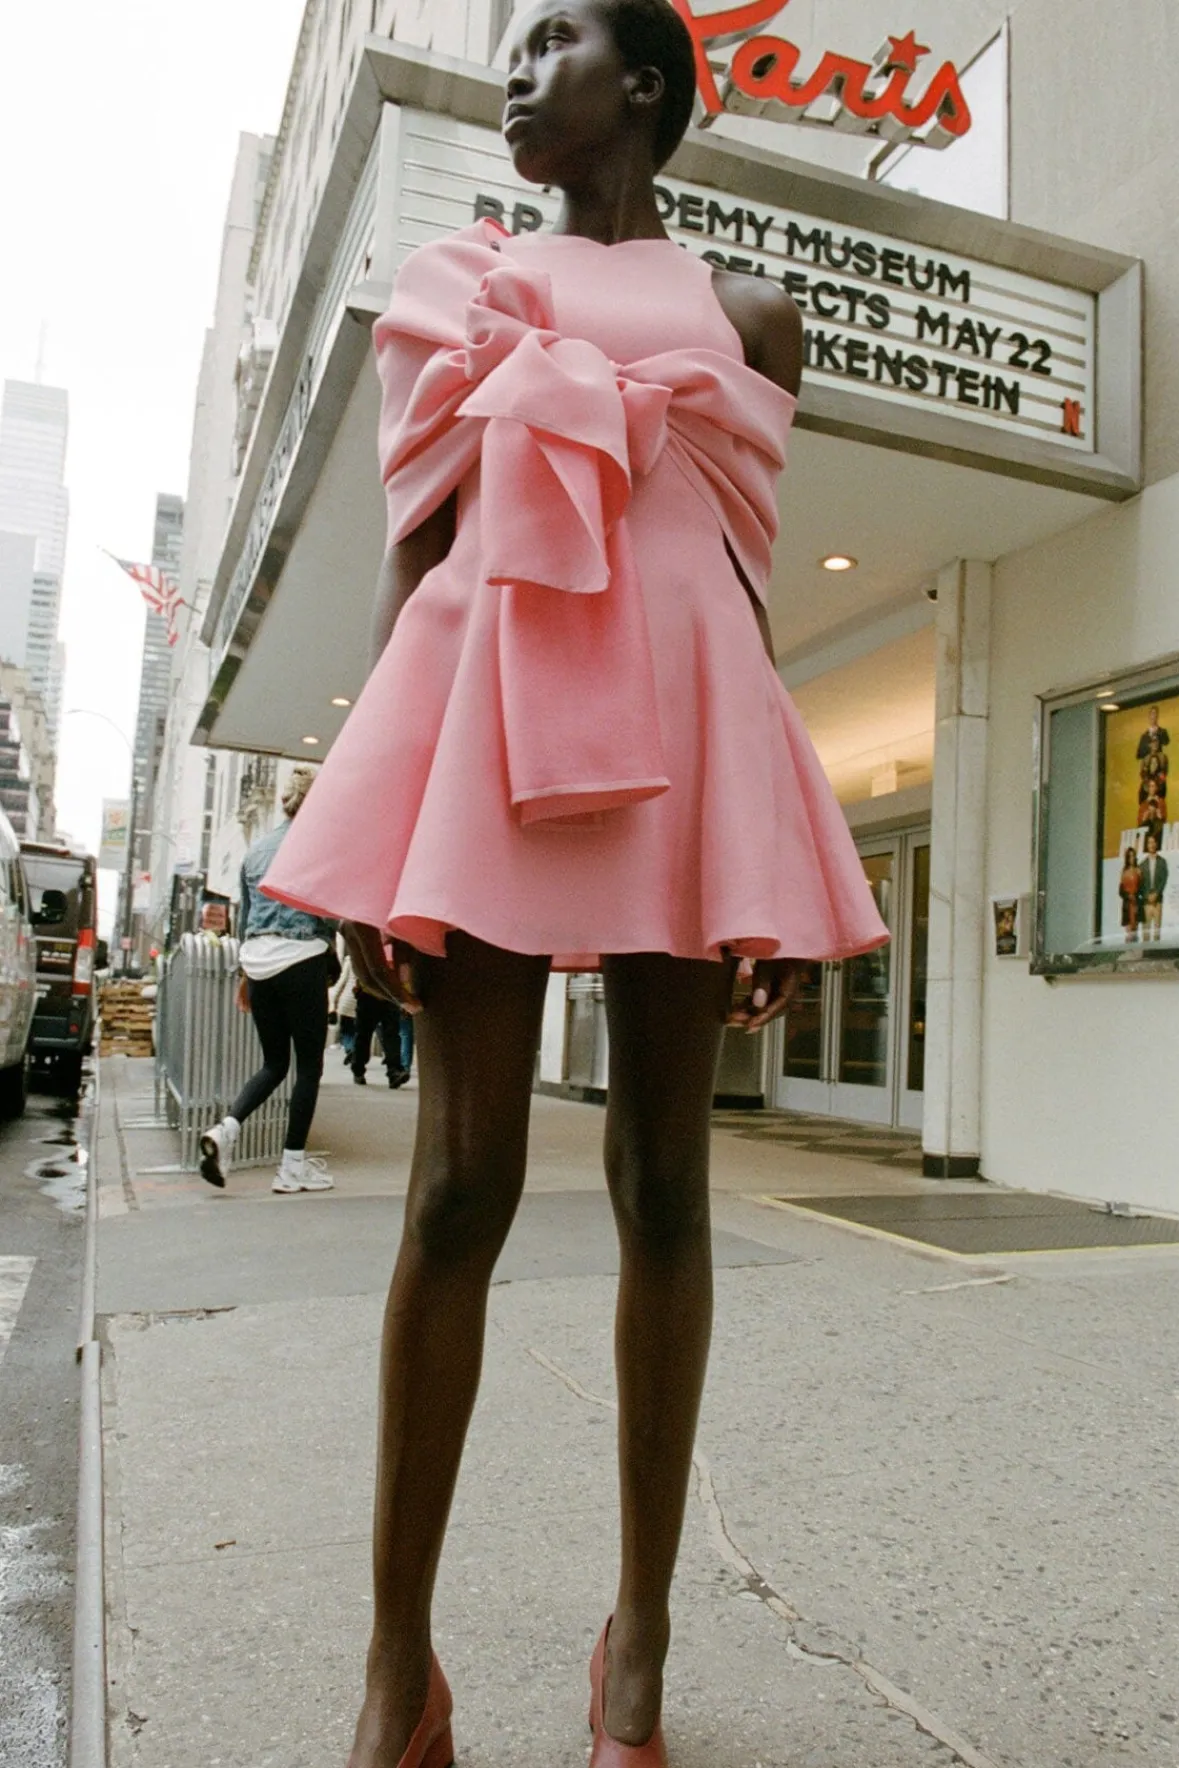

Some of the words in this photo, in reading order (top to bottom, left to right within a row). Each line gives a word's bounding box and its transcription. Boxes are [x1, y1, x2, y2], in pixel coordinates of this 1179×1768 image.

[785, 221, 971, 304] MUSEUM
[915, 305, 1002, 360] MAY
[1008, 332, 1053, 376] 22
[1060, 397, 1081, 437] N
